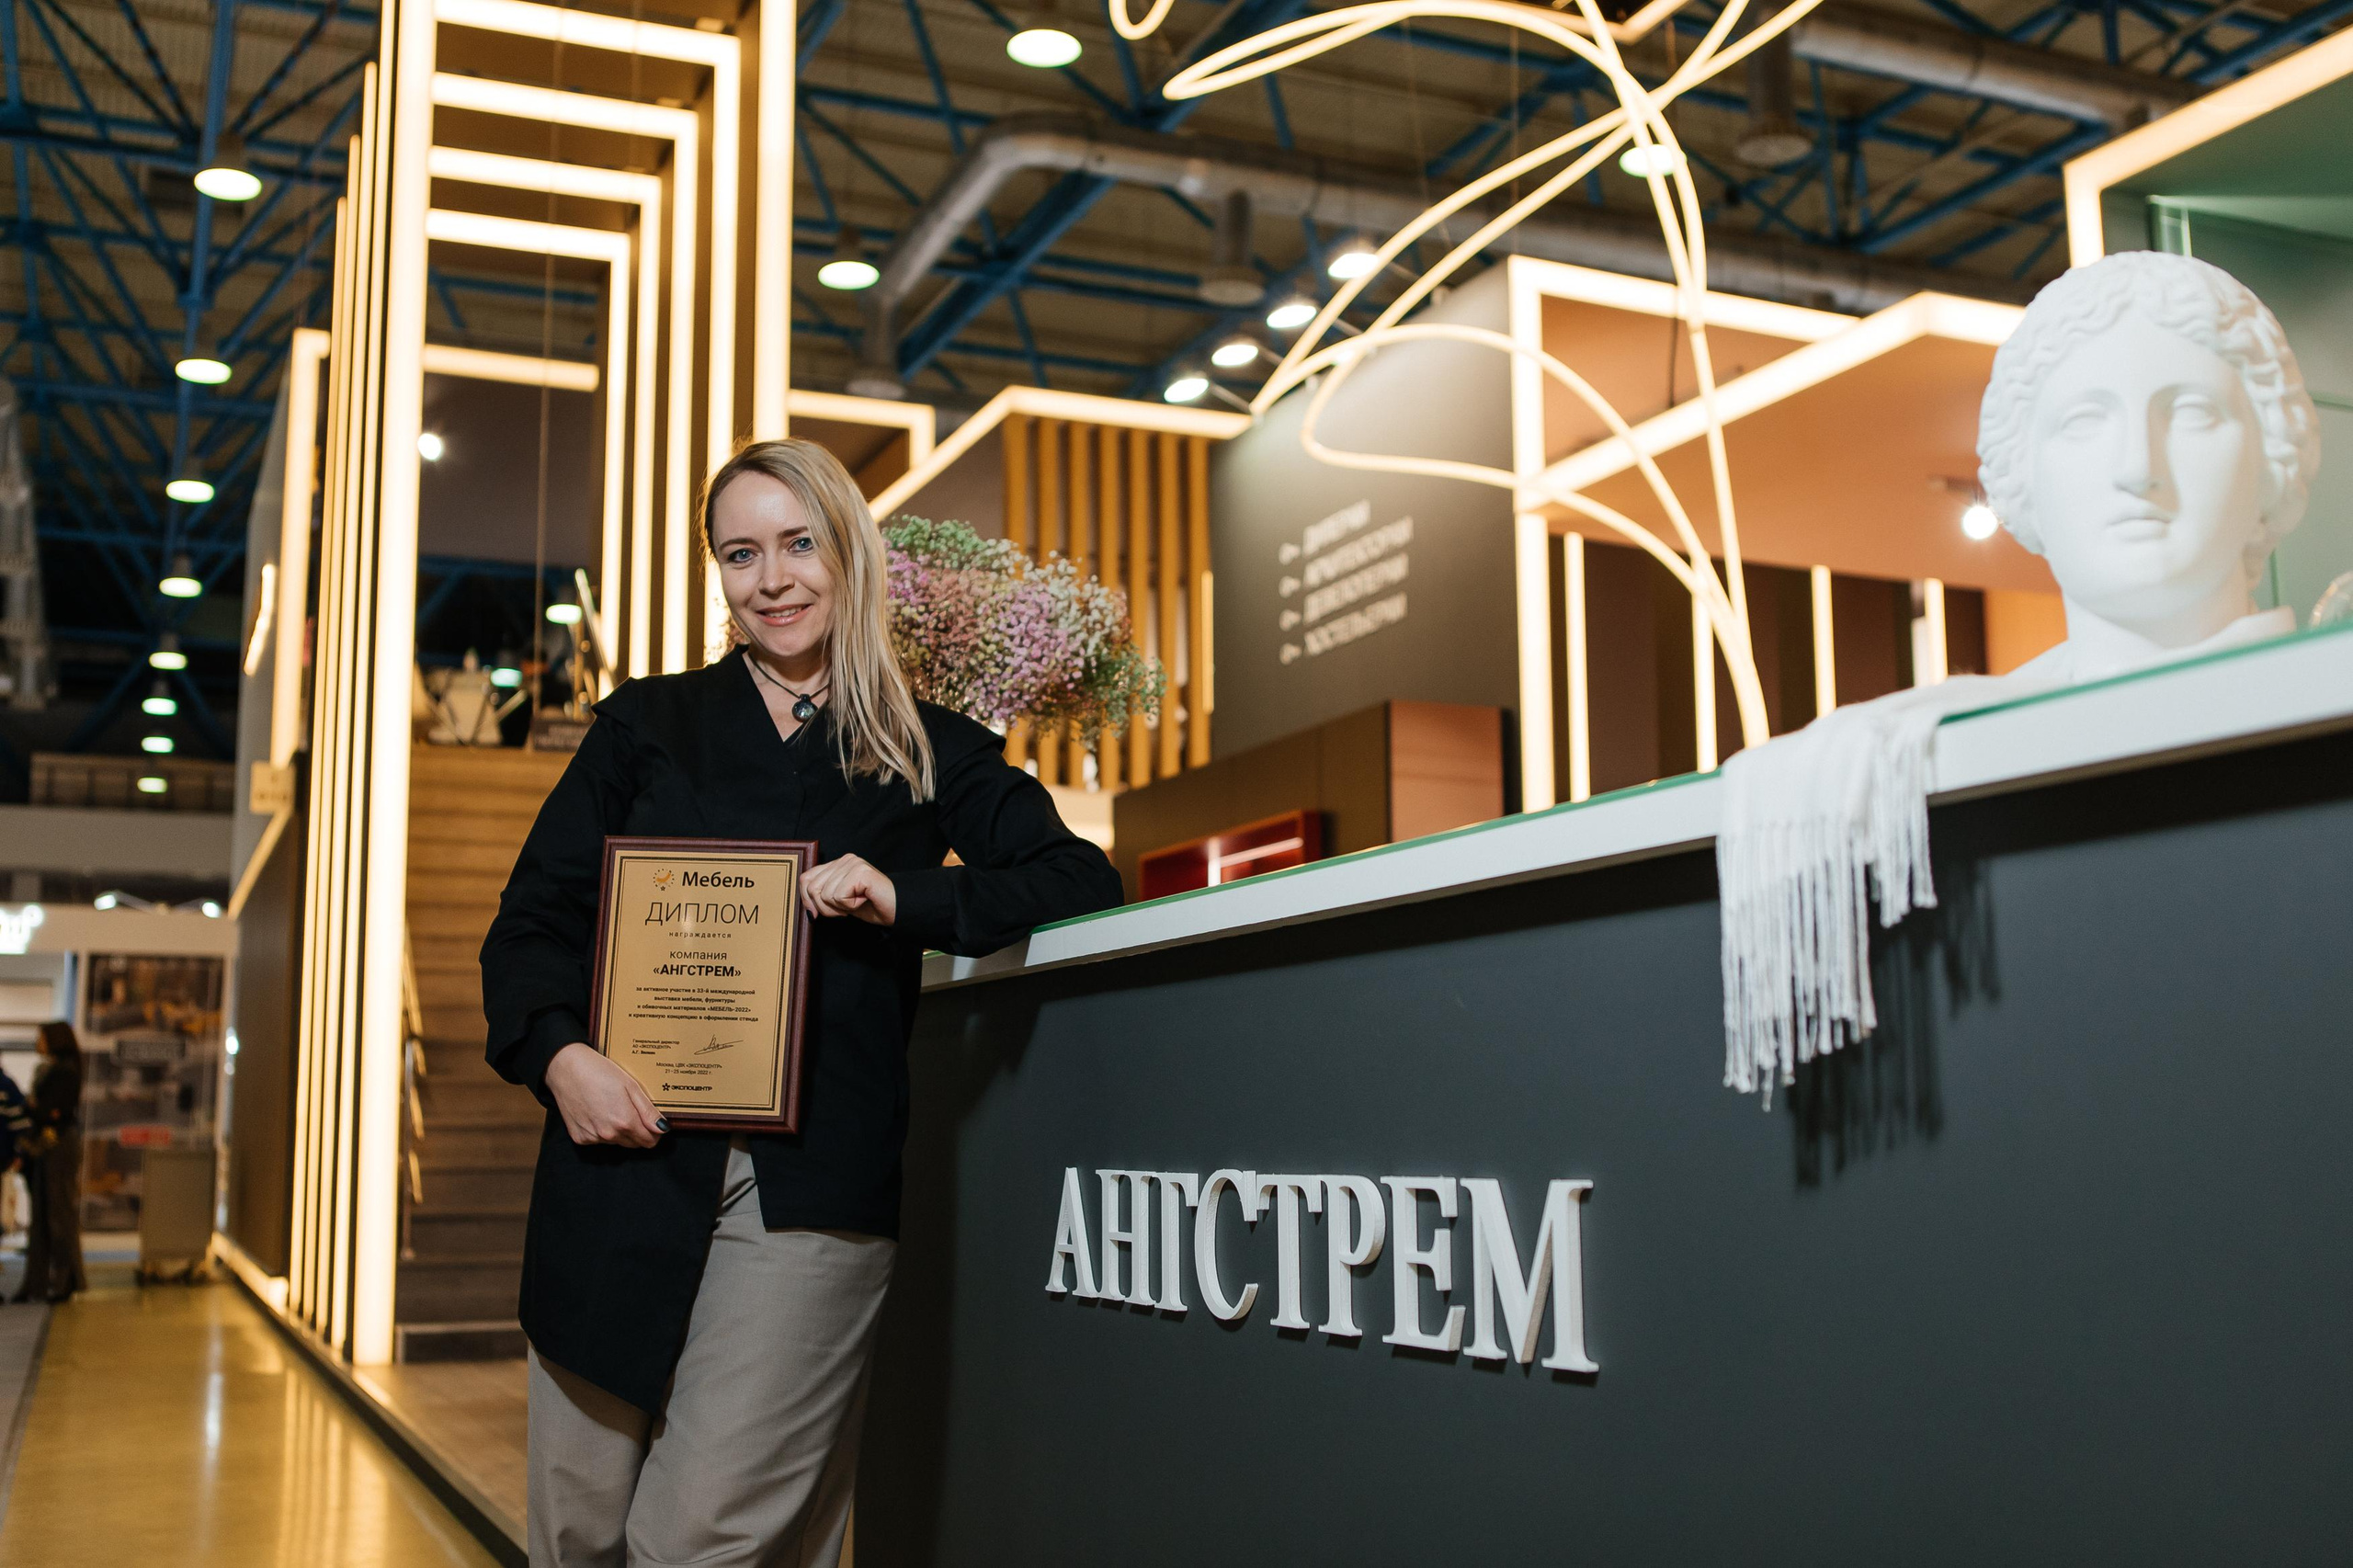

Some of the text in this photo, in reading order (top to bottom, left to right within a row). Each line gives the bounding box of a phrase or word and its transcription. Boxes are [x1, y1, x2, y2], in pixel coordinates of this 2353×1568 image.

[682, 871, 755, 888] Мебель
[644, 902, 759, 926] ДИПЛОМ
[670, 951, 727, 960] компания
[653, 965, 741, 977] «АНГСТРЕМ»
[1045, 1167, 1599, 1373] АНГСТРЕМ
